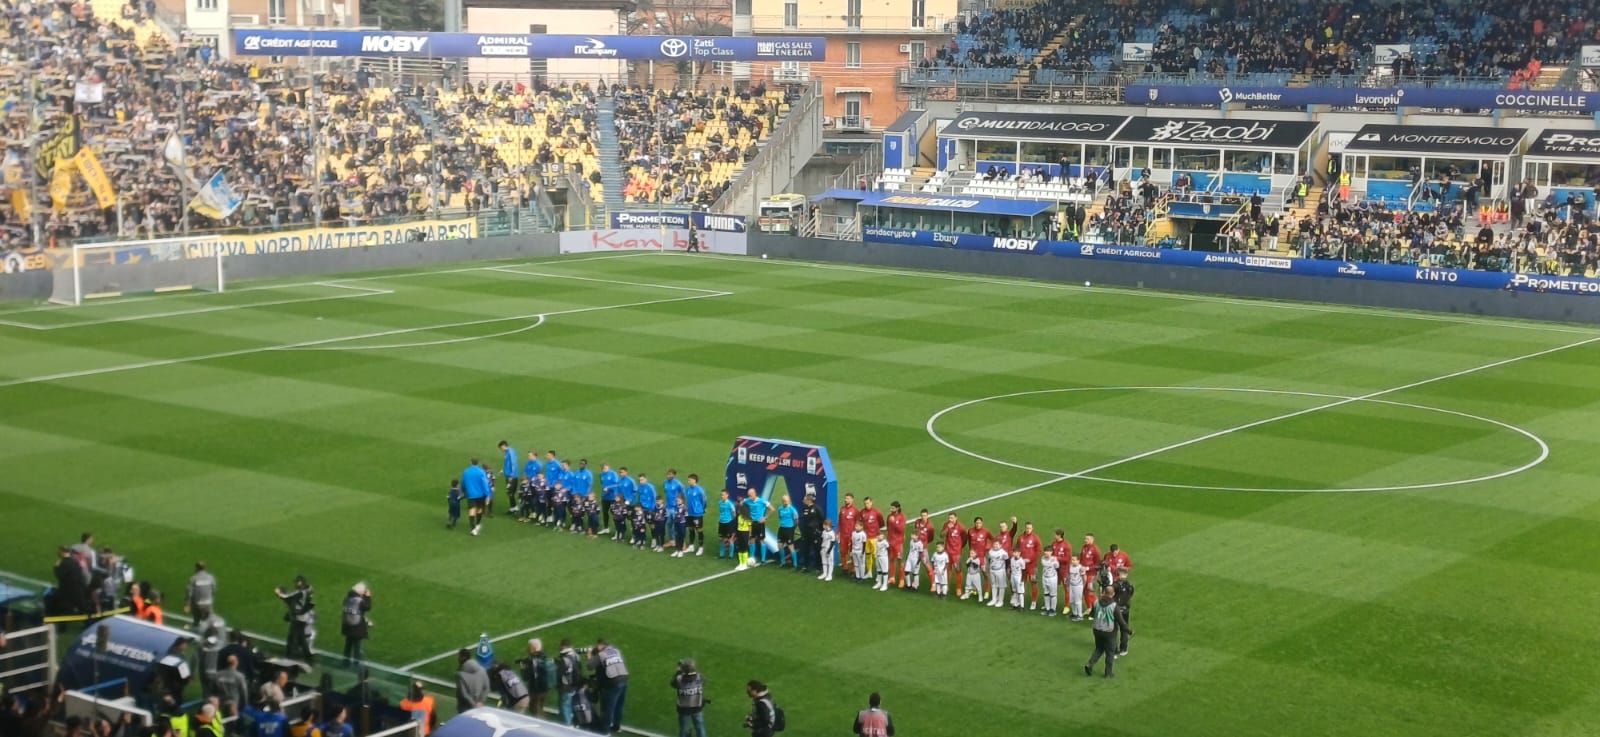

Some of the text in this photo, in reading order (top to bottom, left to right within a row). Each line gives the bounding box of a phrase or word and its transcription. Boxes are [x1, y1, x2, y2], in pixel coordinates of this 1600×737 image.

[361, 35, 429, 52] MOBY
[477, 36, 532, 46] ADMIRAL
[694, 39, 714, 47] Zatti
[694, 48, 735, 56] Top Class
[1235, 92, 1281, 101] MuchBetter
[1495, 94, 1587, 107] COCCINELLE
[976, 119, 1105, 132] MULTIDIALOGO
[1170, 120, 1277, 141] Zacobi
[1388, 134, 1515, 146] MONTEZEMOLO
[616, 214, 685, 225] PROMETEON
[704, 216, 735, 230] PUMA
[255, 236, 302, 254] NORD
[933, 232, 959, 246] Ebury
[993, 237, 1038, 250] MOBY
[1124, 250, 1161, 258] AGRICOLE
[1205, 254, 1245, 265] ADMIRAL
[1510, 274, 1600, 292] PROMETEO
[749, 453, 765, 463] KEEP
[792, 459, 805, 468] OUT
